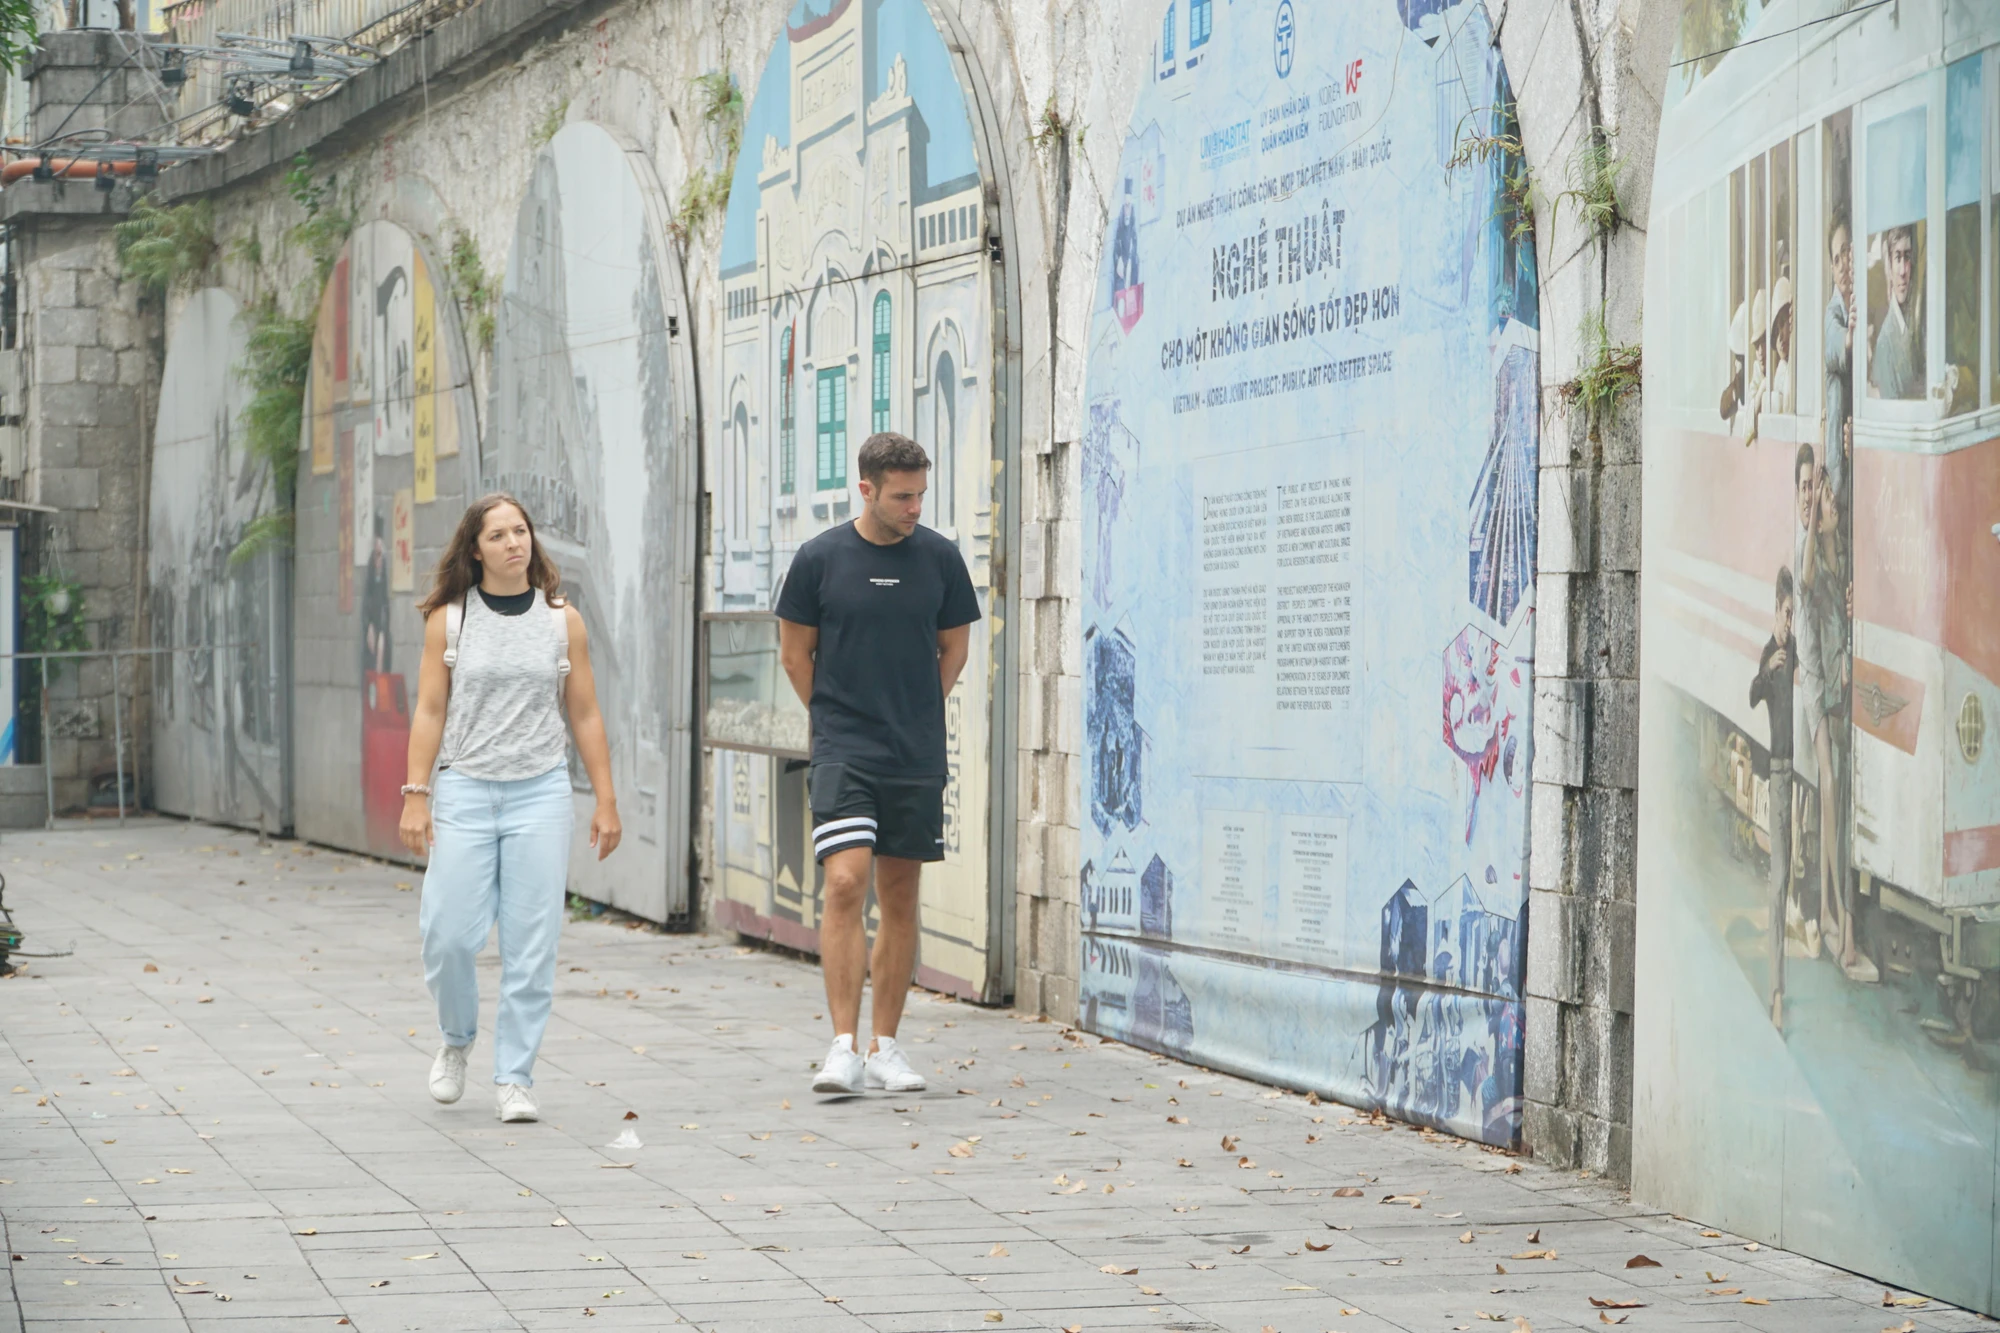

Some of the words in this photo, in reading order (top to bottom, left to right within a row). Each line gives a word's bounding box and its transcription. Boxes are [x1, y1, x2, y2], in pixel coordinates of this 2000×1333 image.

[1319, 82, 1341, 106] KOREA
[1345, 58, 1363, 95] KF
[1319, 100, 1362, 131] FOUNDATION
[1212, 218, 1268, 303] NGHỆ
[1275, 197, 1346, 285] THUẬT
[1161, 336, 1182, 370] CHO
[1186, 327, 1207, 372] MỘT
[1210, 319, 1248, 359] KHÔNG
[1252, 314, 1280, 350] GIAN
[1283, 297, 1316, 342] SỐNG
[1319, 287, 1341, 332] TỐT
[1345, 293, 1368, 334] ĐẸP
[1372, 283, 1400, 321] HƠN
[1173, 391, 1200, 415] VIETNAM
[1206, 385, 1227, 408] KOREA
[1229, 381, 1248, 405] JOINT
[1249, 377, 1281, 400] PROJECT:
[1282, 371, 1306, 393] PUBLIC
[1308, 366, 1321, 388] ART
[1323, 362, 1338, 384] FOR
[1338, 357, 1366, 382] BETTER
[1368, 351, 1393, 375] SPACE
